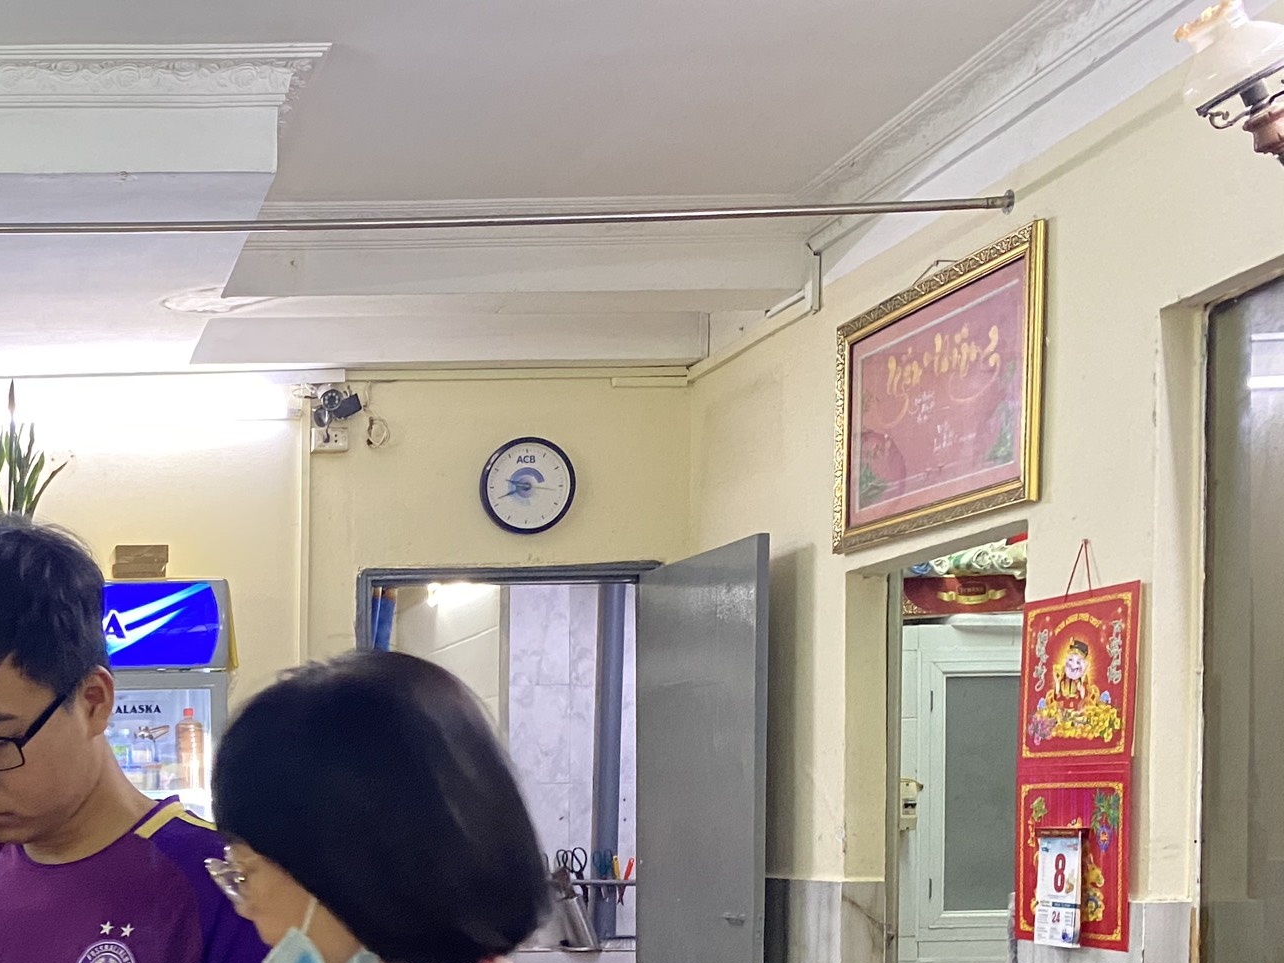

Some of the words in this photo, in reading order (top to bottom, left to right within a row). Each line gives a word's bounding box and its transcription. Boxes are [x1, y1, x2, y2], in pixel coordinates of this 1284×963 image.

[516, 455, 536, 464] ACB
[104, 612, 126, 639] A
[115, 704, 162, 715] ALASKA
[1053, 853, 1066, 893] 8
[1051, 911, 1061, 924] 24
